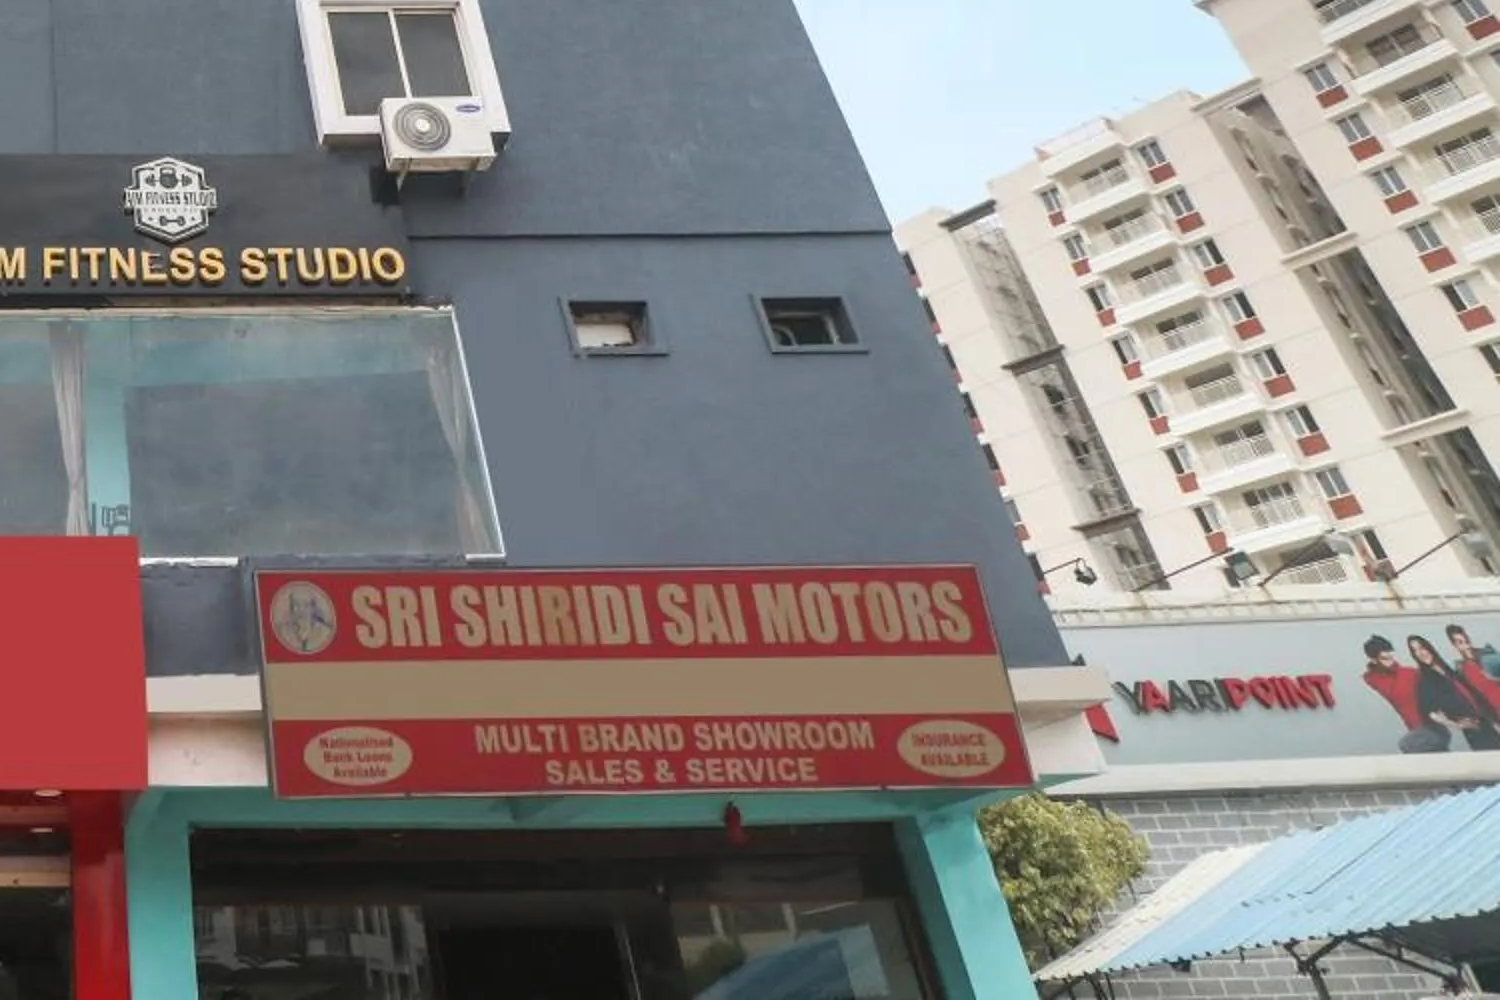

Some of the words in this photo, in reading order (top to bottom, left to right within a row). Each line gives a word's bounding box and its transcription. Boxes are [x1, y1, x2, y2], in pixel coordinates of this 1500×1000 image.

[41, 246, 227, 281] FITNESS
[240, 246, 407, 281] STUDIO
[351, 584, 442, 649] SRI
[450, 584, 653, 648] SHIRIDI
[656, 582, 749, 646] SAI
[751, 580, 973, 645] MOTORS
[474, 723, 569, 754] MULTI
[579, 722, 686, 753] BRAND
[694, 721, 875, 752] SHOWROOM
[911, 732, 987, 747] INSURANCE
[545, 758, 644, 785] SALES
[654, 758, 677, 784] &
[686, 757, 819, 783] SERVICE
[920, 752, 990, 767] AVAILABLE
